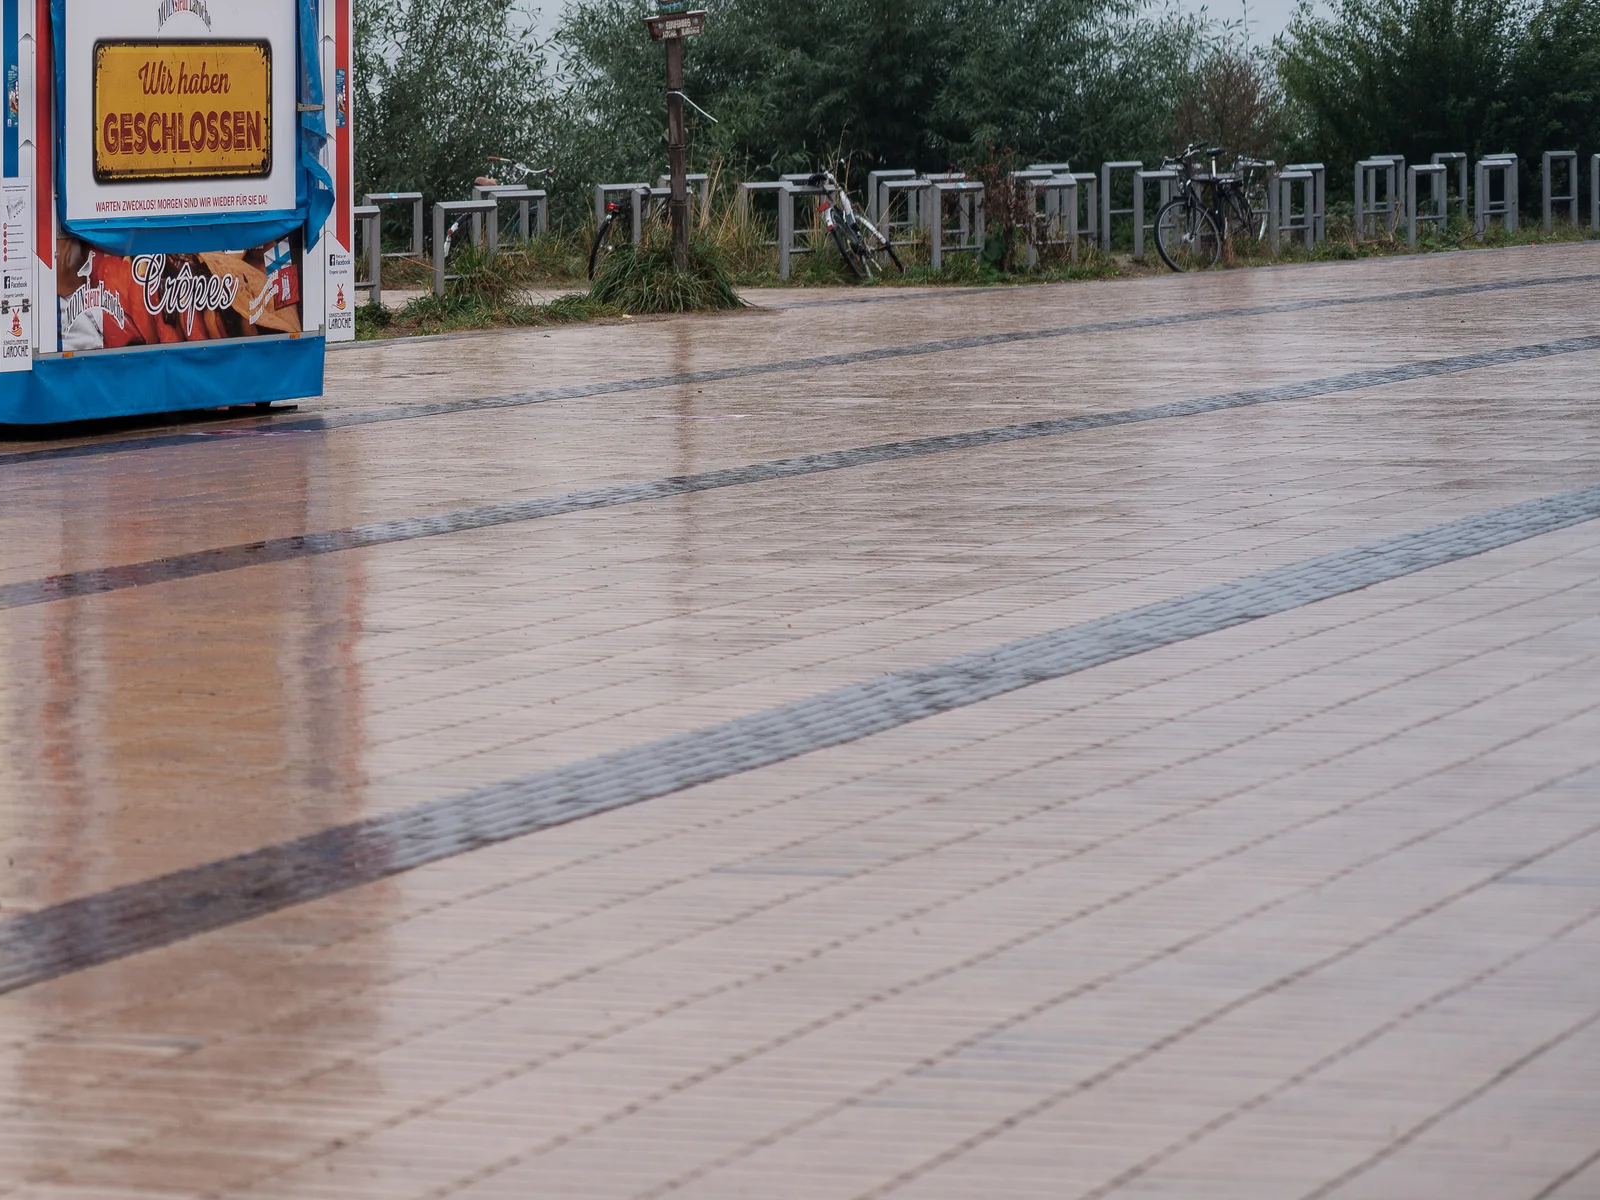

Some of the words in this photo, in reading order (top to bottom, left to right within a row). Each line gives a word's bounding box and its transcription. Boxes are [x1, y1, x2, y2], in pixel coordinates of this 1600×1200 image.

[138, 60, 175, 95] Wir
[177, 61, 231, 95] haben
[103, 110, 262, 155] GESCHLOSSEN
[96, 200, 121, 212] WARTEN
[122, 199, 157, 211] ZWECKLOS!
[157, 198, 183, 210] MORGEN
[184, 197, 198, 209] SIND
[199, 197, 211, 208] WIR
[212, 195, 235, 207] WIEDER
[236, 193, 248, 206] FÜR
[248, 195, 257, 205] SIE
[258, 194, 268, 205] DA!
[132, 254, 238, 336] Crêpes
[329, 317, 351, 329] LAROCHE
[3, 344, 28, 358] LAROCHE
